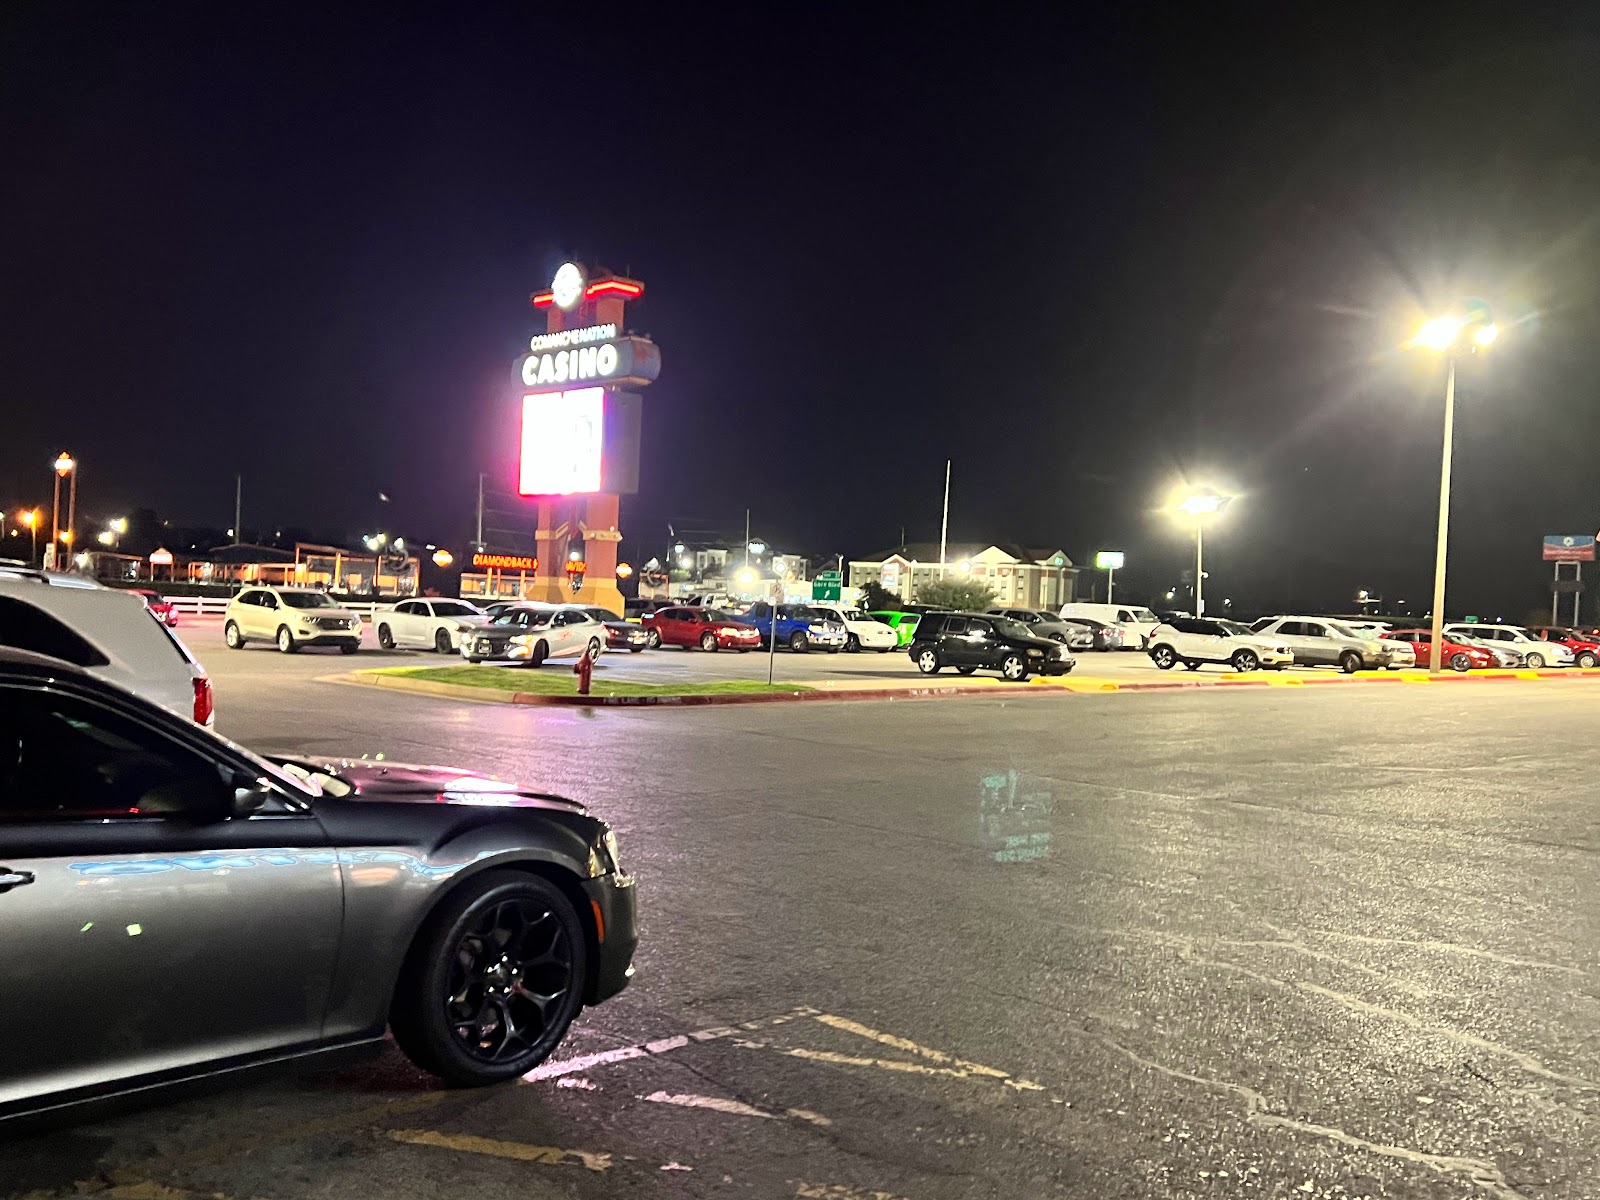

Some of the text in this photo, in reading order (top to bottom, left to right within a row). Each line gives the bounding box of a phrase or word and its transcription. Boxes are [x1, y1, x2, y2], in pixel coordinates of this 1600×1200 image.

[580, 323, 616, 342] NATION
[522, 344, 617, 386] CASINO
[473, 554, 532, 568] DIAMONDBACK
